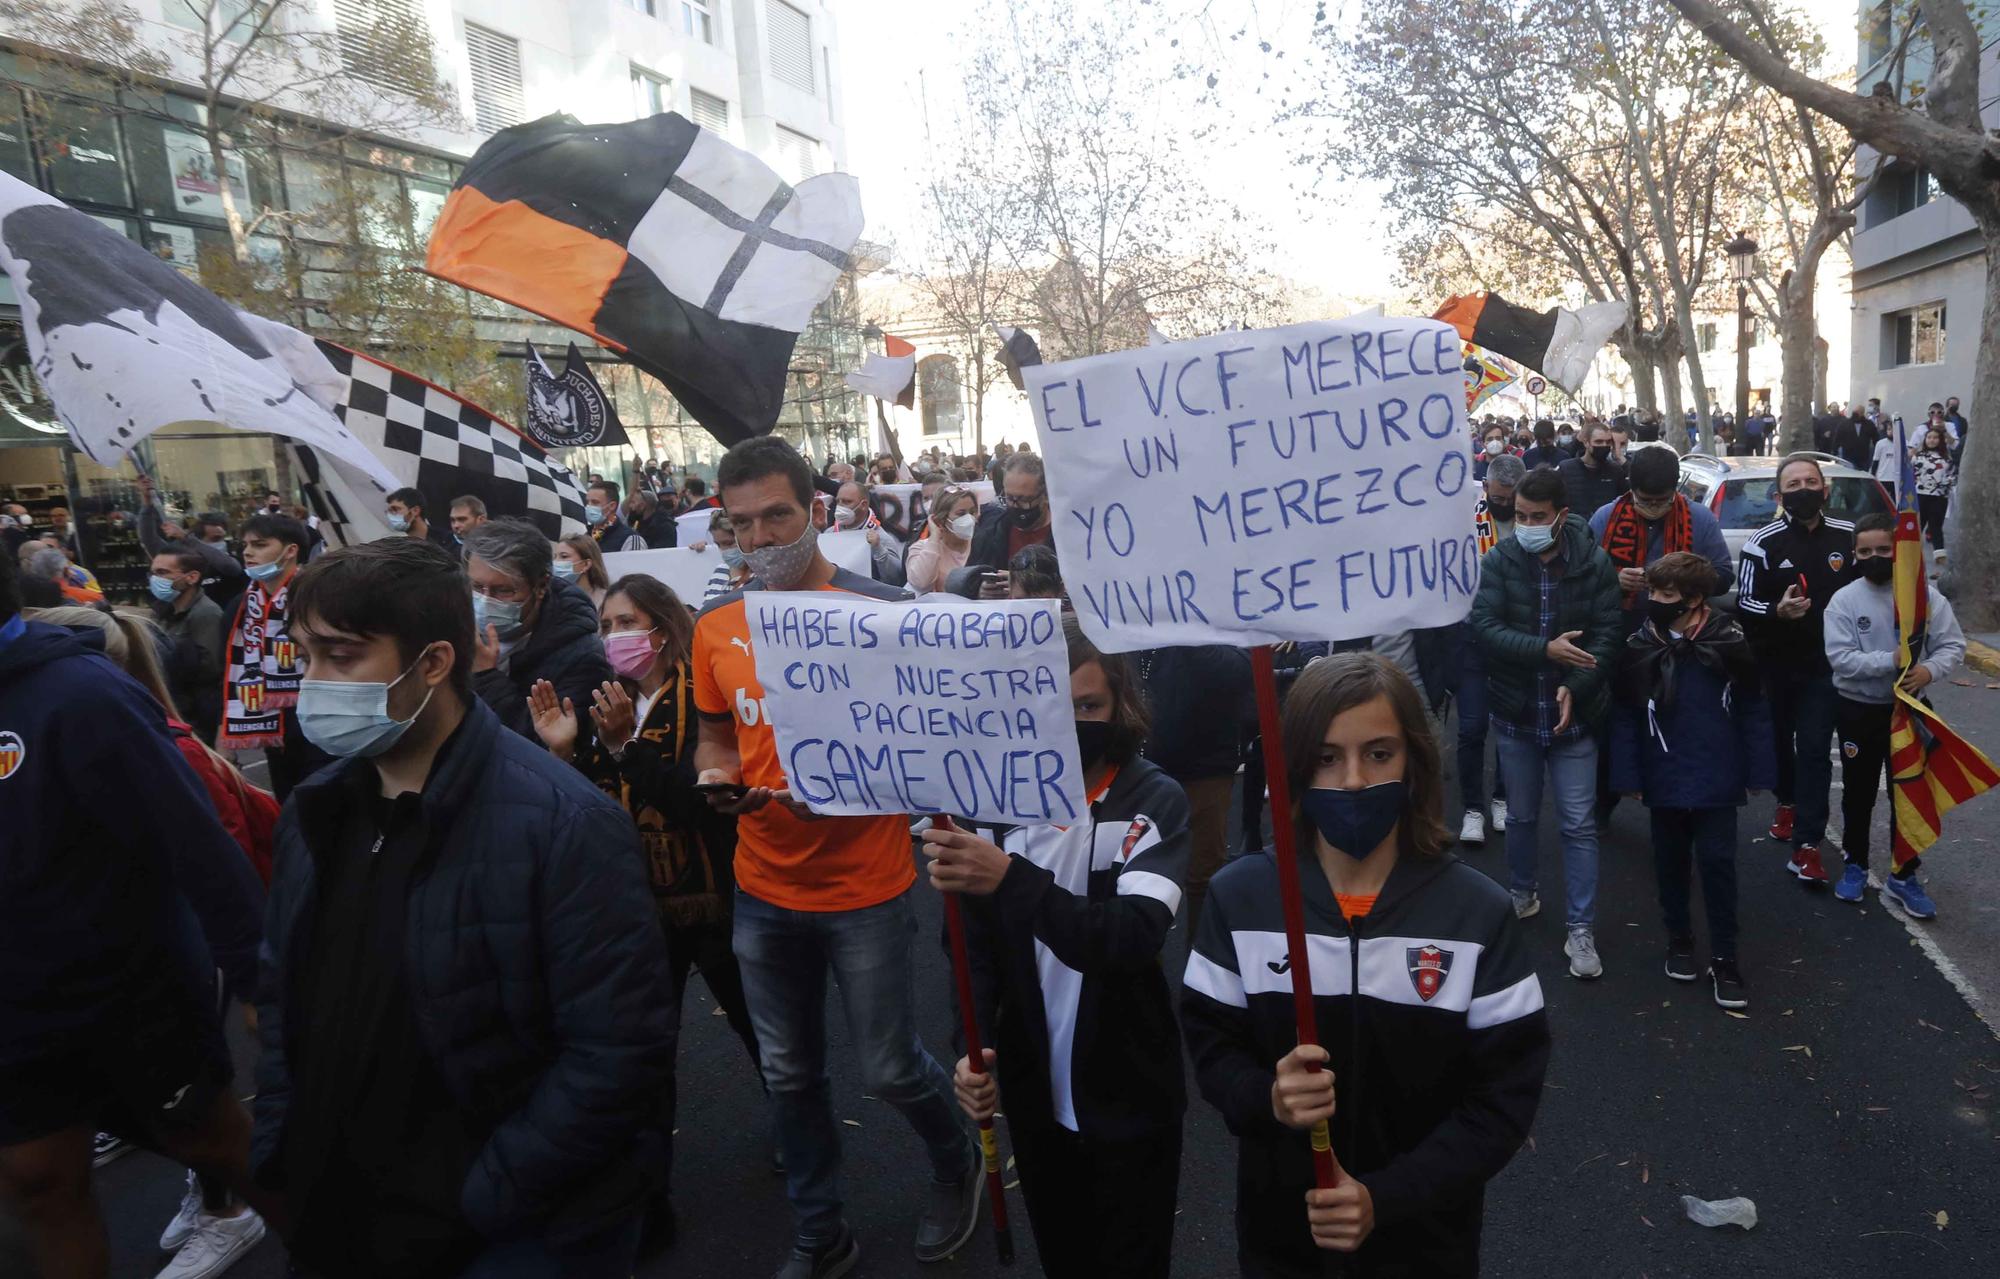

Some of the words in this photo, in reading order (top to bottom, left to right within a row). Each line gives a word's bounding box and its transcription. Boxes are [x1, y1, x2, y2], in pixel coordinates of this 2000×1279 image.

[1042, 379, 1101, 432] EL
[1282, 328, 1461, 400] MERECE
[1123, 428, 1179, 479] UN
[1072, 503, 1135, 560] YO
[1192, 450, 1467, 547] MEREZCO
[1083, 569, 1210, 630] VIVIR
[1233, 559, 1320, 621] ESE
[1336, 533, 1479, 614] FUTURO
[760, 605, 879, 650] HABEIS
[899, 607, 1054, 649] ACABADO
[784, 662, 850, 693] CON
[895, 664, 1057, 700] NUESTRA
[850, 700, 1037, 739] PACIENCIA
[790, 738, 942, 813] GAME
[943, 748, 1077, 819] OVER
